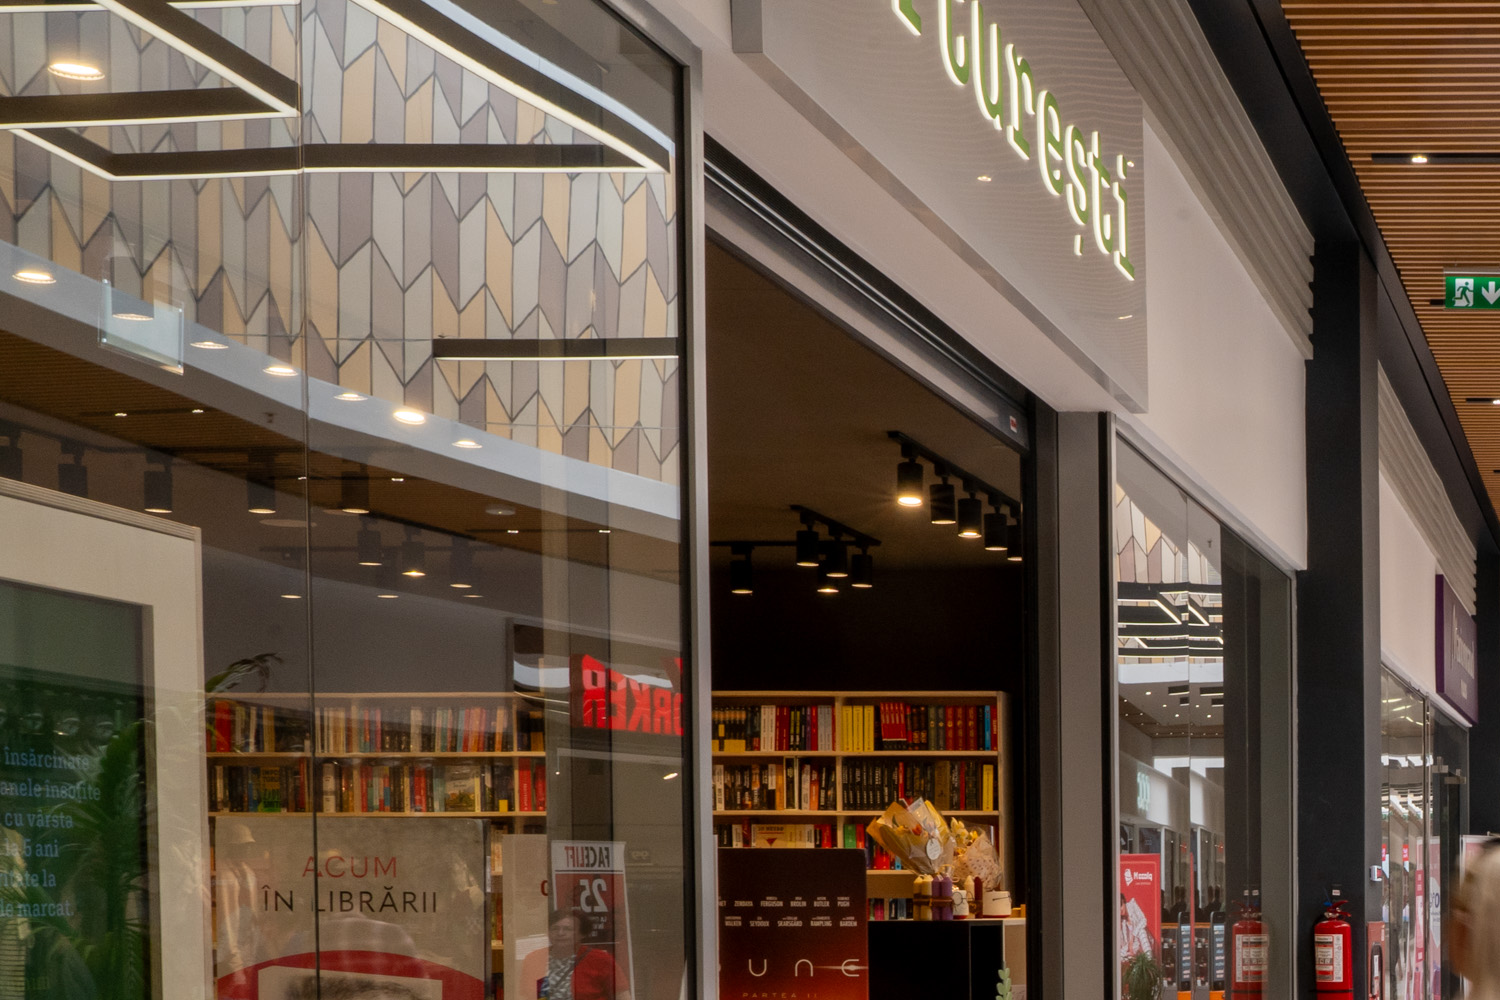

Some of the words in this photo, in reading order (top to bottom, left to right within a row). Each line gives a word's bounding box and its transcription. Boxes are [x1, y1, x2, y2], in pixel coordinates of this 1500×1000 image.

[5, 812, 23, 827] cu
[28, 809, 73, 829] vârsta
[23, 839, 33, 856] 5
[35, 840, 59, 858] ani
[302, 856, 397, 878] ACUM
[43, 869, 56, 887] la
[261, 884, 294, 912] ÎN
[311, 886, 437, 913] LIBRĂRII
